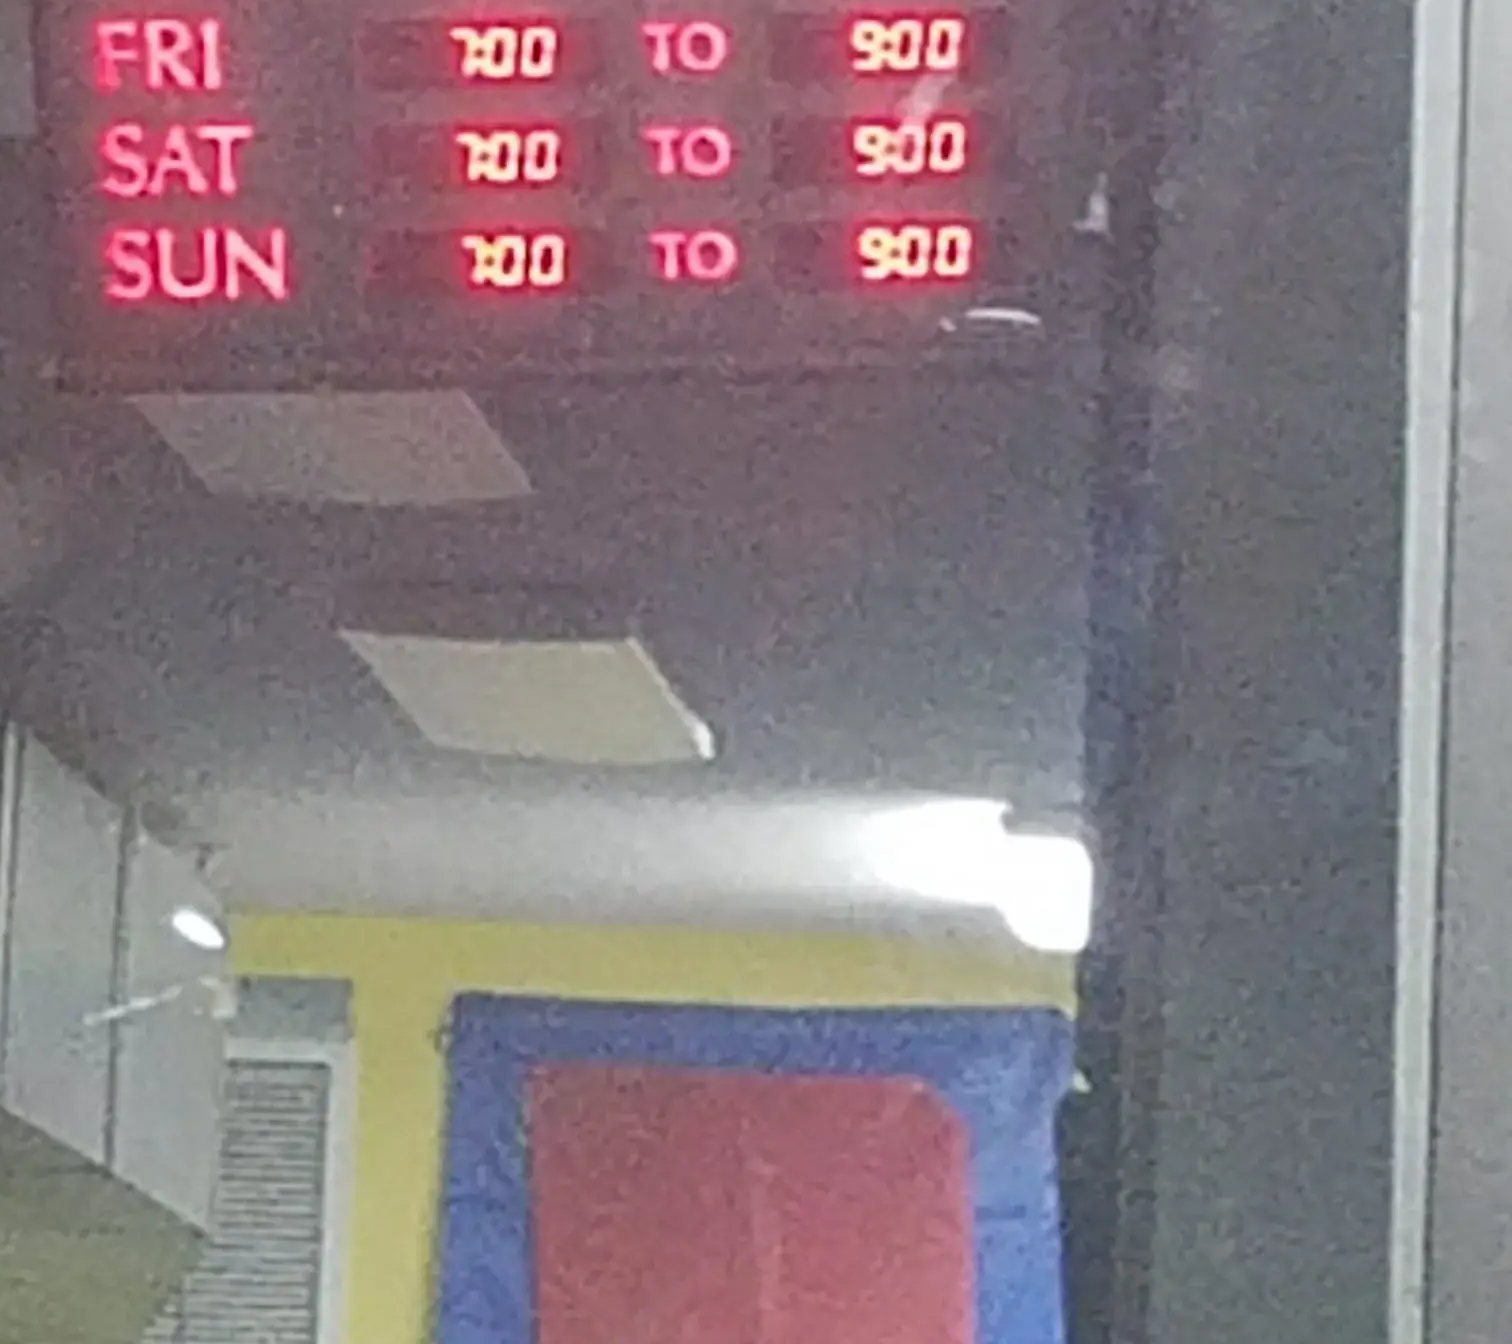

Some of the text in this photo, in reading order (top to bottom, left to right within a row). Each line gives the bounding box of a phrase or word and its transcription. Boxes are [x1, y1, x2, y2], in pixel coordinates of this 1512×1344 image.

[96, 19, 223, 92] FRI
[643, 21, 728, 72] TO
[100, 122, 253, 196] SAT
[646, 125, 731, 176] TO
[104, 226, 288, 299] SUN
[651, 229, 737, 280] TO
